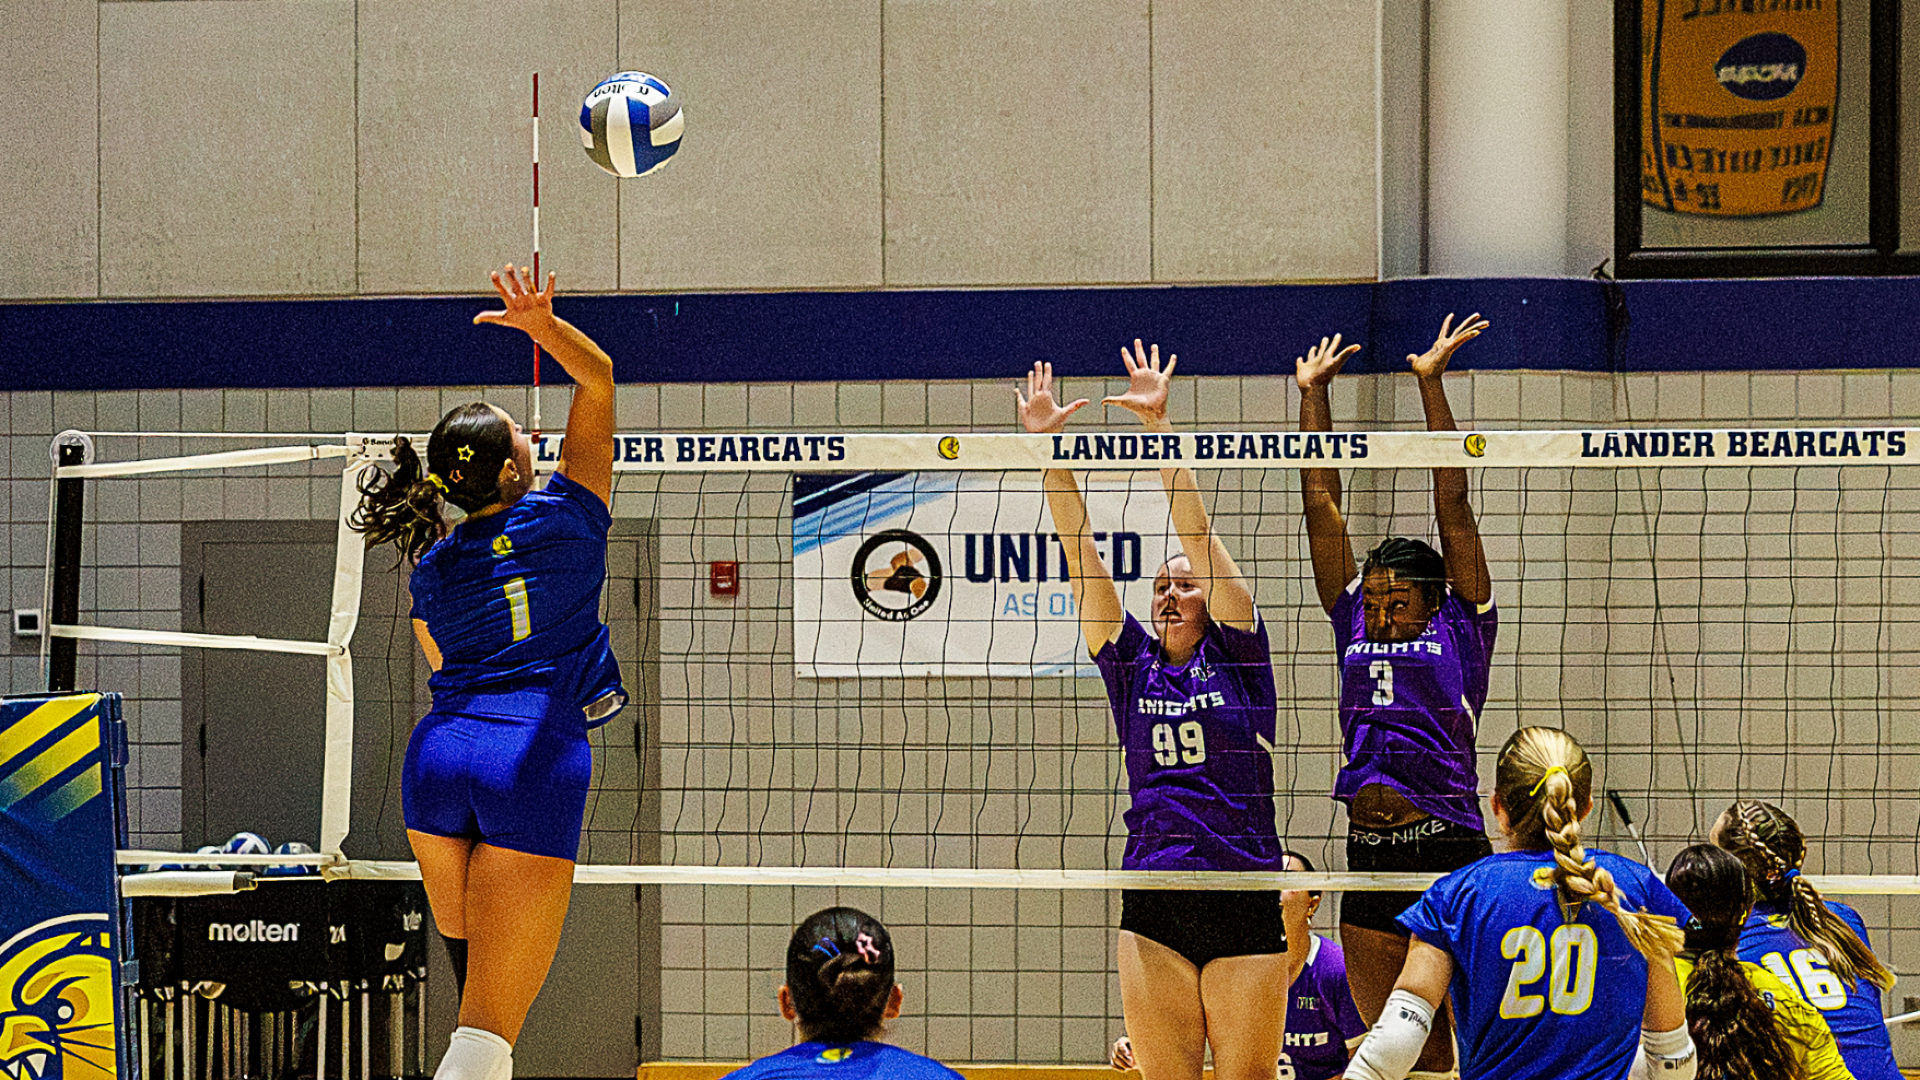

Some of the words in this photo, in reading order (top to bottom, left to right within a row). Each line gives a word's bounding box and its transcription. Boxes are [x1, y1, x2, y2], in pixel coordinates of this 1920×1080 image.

[537, 437, 664, 462] LER
[676, 436, 845, 462] BEARCATS
[1052, 435, 1182, 460] LANDER
[1194, 434, 1368, 459] BEARCATS
[1581, 432, 1715, 457] LANDER
[1727, 431, 1906, 457] BEARCATS
[965, 532, 1141, 583] UNITD
[503, 577, 532, 642] 1
[1003, 593, 1037, 617] AS
[1369, 660, 1394, 706] 3
[1152, 720, 1206, 766] 99
[1391, 820, 1446, 852] NIKE
[208, 919, 299, 942] molten
[1500, 923, 1598, 1020] 20
[1760, 948, 1848, 1011] 16
